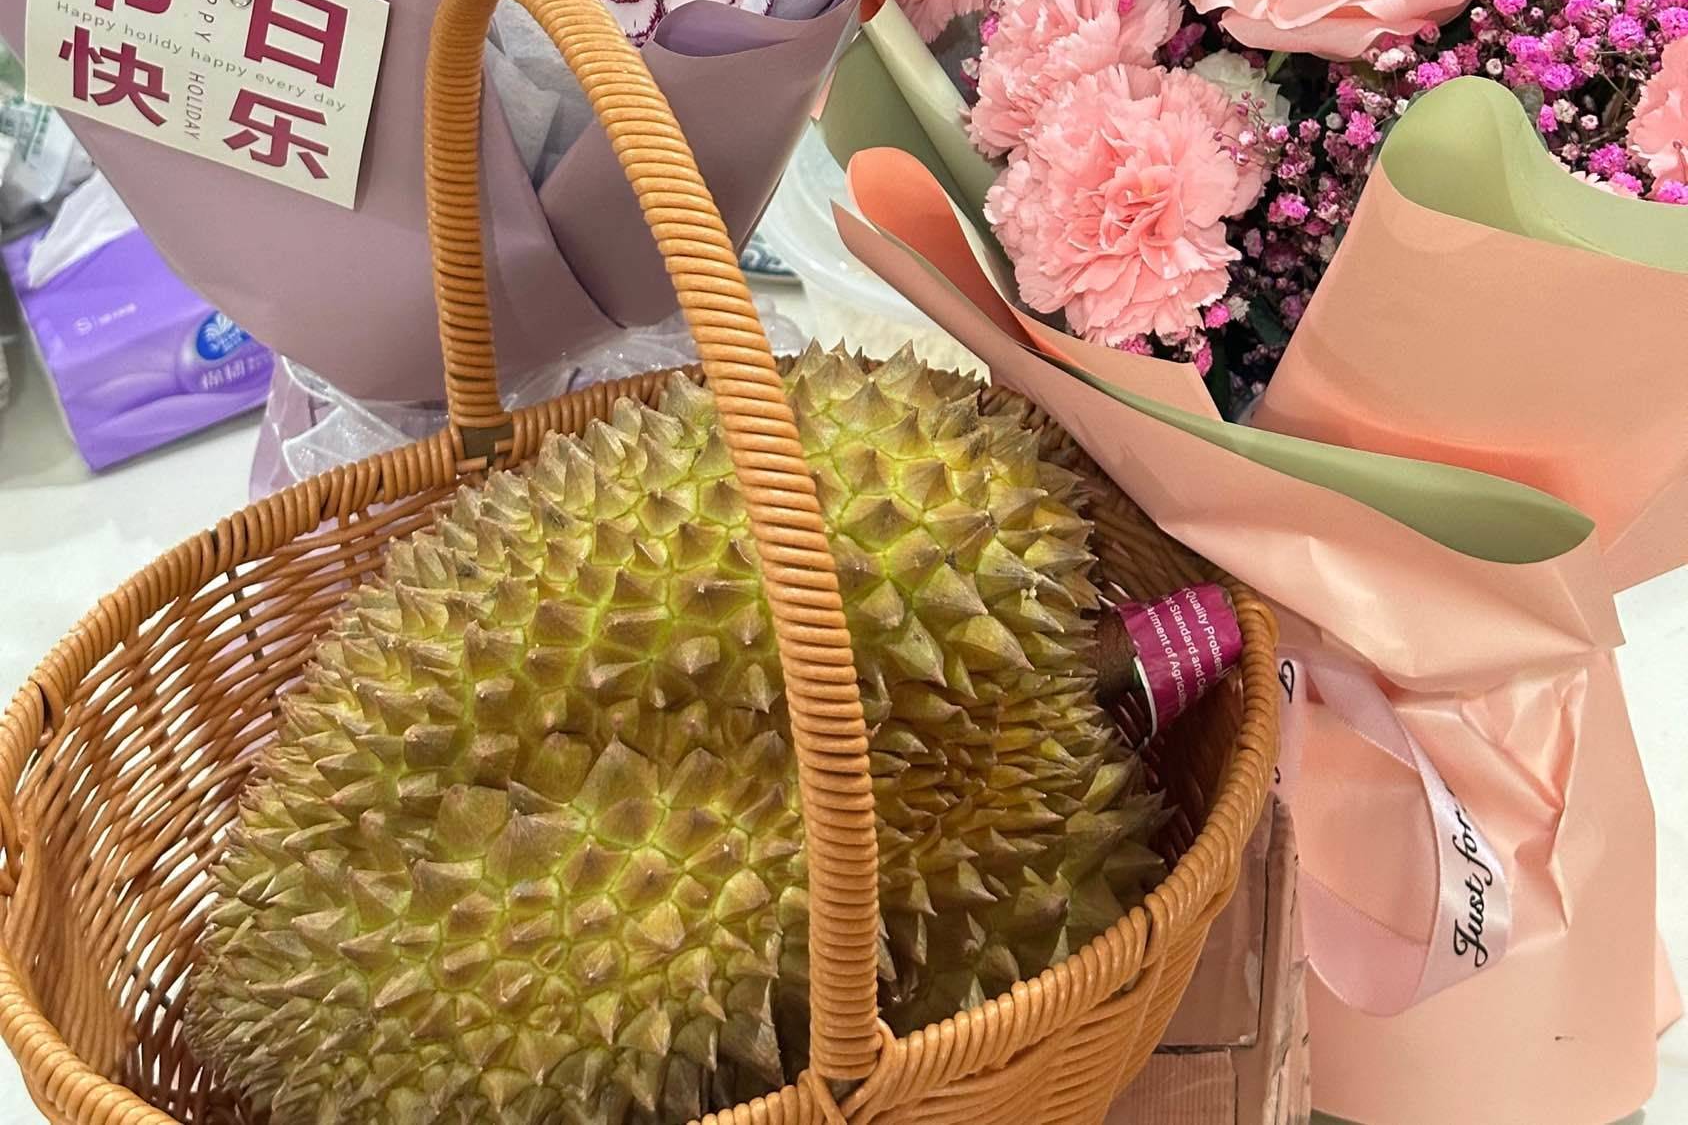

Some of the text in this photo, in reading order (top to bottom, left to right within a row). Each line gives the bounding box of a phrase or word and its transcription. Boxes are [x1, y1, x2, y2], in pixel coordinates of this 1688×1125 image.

[57, 0, 347, 113] Happy holidy happy every day
[184, 71, 206, 141] HOLIDAY
[1169, 605, 1200, 655] Standard
[1192, 656, 1206, 677] and
[1186, 590, 1209, 625] Quality
[1165, 646, 1177, 659] of
[1452, 810, 1492, 887] for
[1453, 872, 1489, 968] Just
